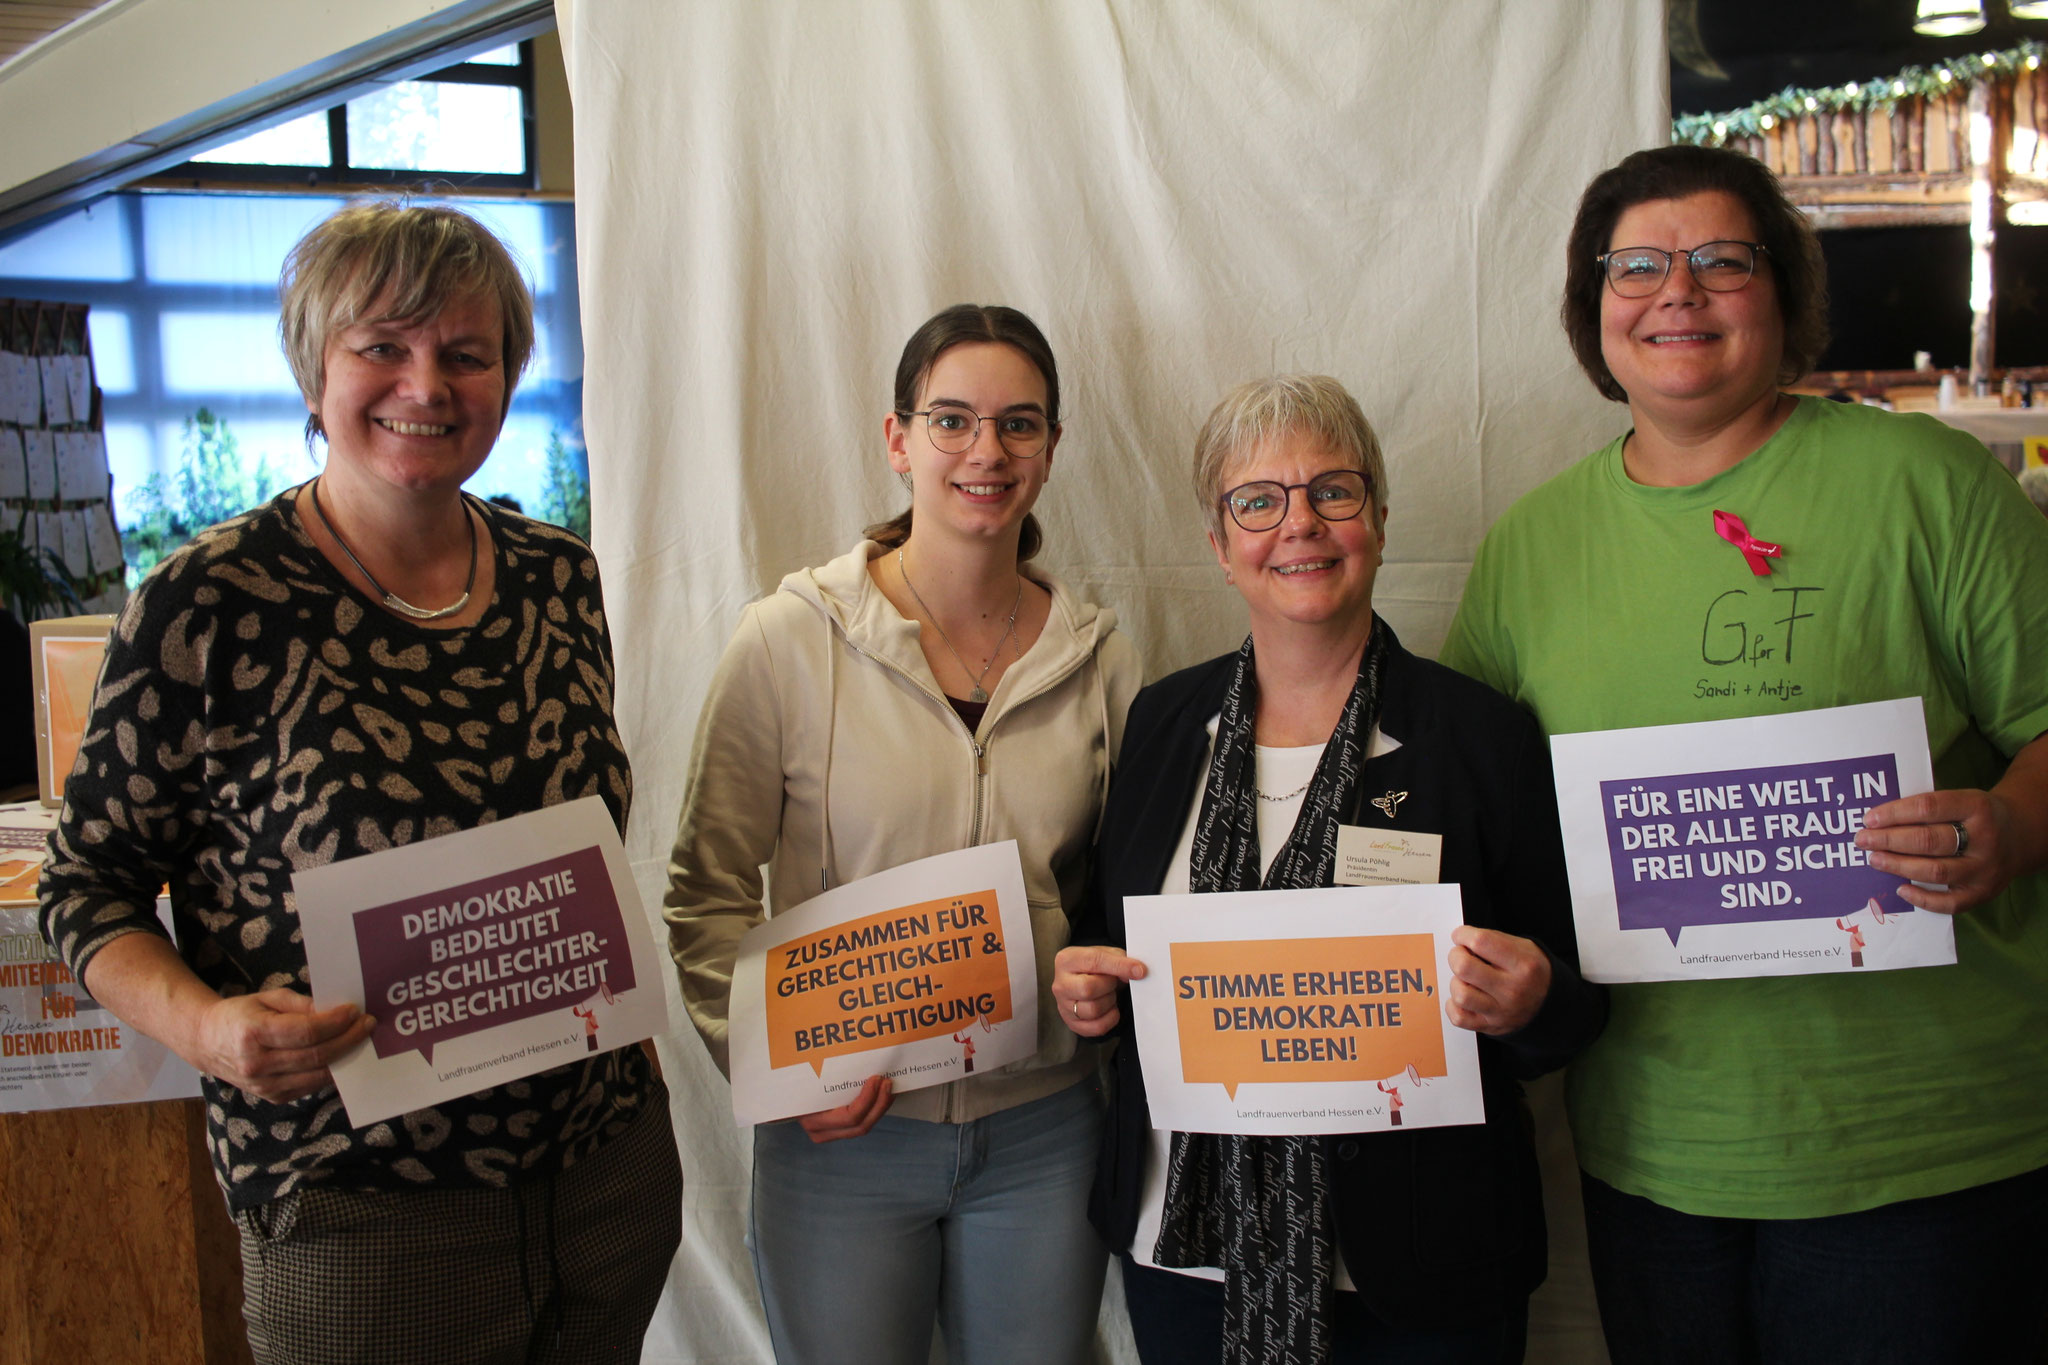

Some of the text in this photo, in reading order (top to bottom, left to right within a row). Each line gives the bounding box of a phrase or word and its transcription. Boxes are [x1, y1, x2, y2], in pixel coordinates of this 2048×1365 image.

[1693, 679, 1737, 698] Sandi
[1758, 679, 1803, 701] Antje
[1208, 731, 1234, 798] LandFrauen
[1224, 660, 1246, 726] LandFrauen
[1331, 739, 1360, 812] LandFrauen
[1613, 770, 1888, 819] FÜR EINE WELT, IN
[1191, 803, 1219, 871] LandFrauen
[1621, 807, 1872, 851] DER ALLE FRAUE
[1346, 855, 1368, 864] Ursula
[1633, 841, 1873, 882] FREI UND SICHE
[402, 869, 577, 940] DEMOKRATIE
[1720, 880, 1803, 909] SIND.
[431, 907, 561, 963] BEDEUTET
[785, 901, 989, 970] ZUSAMMEN FÜR
[1680, 946, 1844, 965] Landfrauenverband Hessen e.V.
[0, 962, 76, 987] MITEINA
[387, 931, 608, 1006] GESCHLECHTER-
[777, 932, 1004, 998] GERECHTIGKEIT &
[1178, 968, 1434, 1000] STIMME ERHEBEN,
[42, 992, 76, 1019] FÜR
[395, 959, 608, 1036] GERECHTIGKEIT
[838, 974, 943, 1012] GLEICH-
[1213, 1002, 1402, 1031] DEMOKRATIE
[2, 1027, 121, 1057] DEMOKRATIE
[795, 993, 996, 1053] BERECHTIGUNG
[438, 1033, 581, 1083] Landfrauenverband Hessen e.V.
[909, 1062, 942, 1074] Hessen
[944, 1057, 960, 1068] e.V.
[1261, 1036, 1358, 1063] LEBEN!
[1236, 1106, 1384, 1119] Landfrauenverband Hessen e.V.
[1311, 1152, 1328, 1230] LandFrauen
[1285, 1189, 1305, 1267] LandFrauen
[1311, 1236, 1329, 1312] LandFrauen
[1286, 1272, 1305, 1347] LandFrauen
